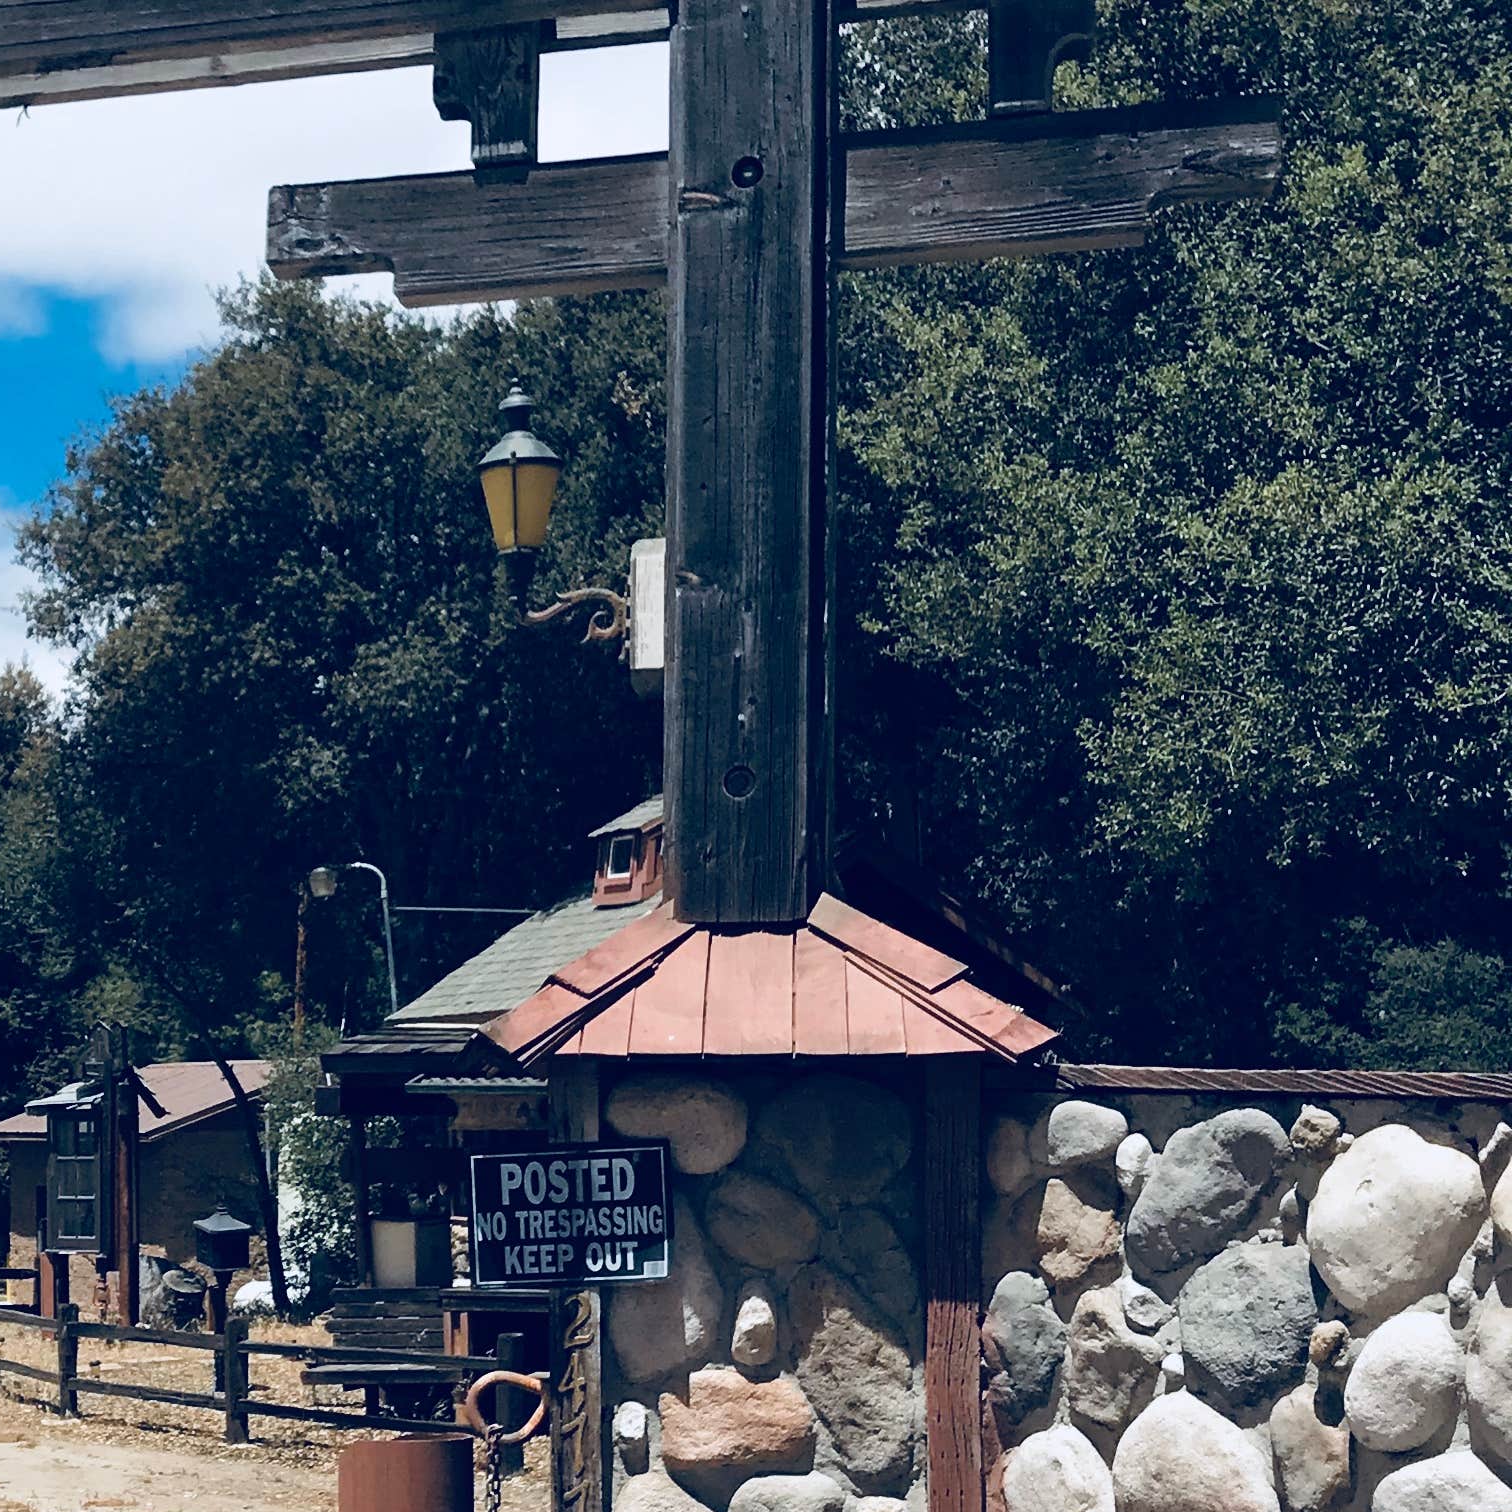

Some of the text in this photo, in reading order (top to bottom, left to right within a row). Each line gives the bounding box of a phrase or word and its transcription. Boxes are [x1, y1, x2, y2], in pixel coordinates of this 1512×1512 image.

[500, 1158, 635, 1205] POSTED
[477, 1205, 663, 1241] NO TRESPASSING
[504, 1241, 638, 1274] KEEP OUT
